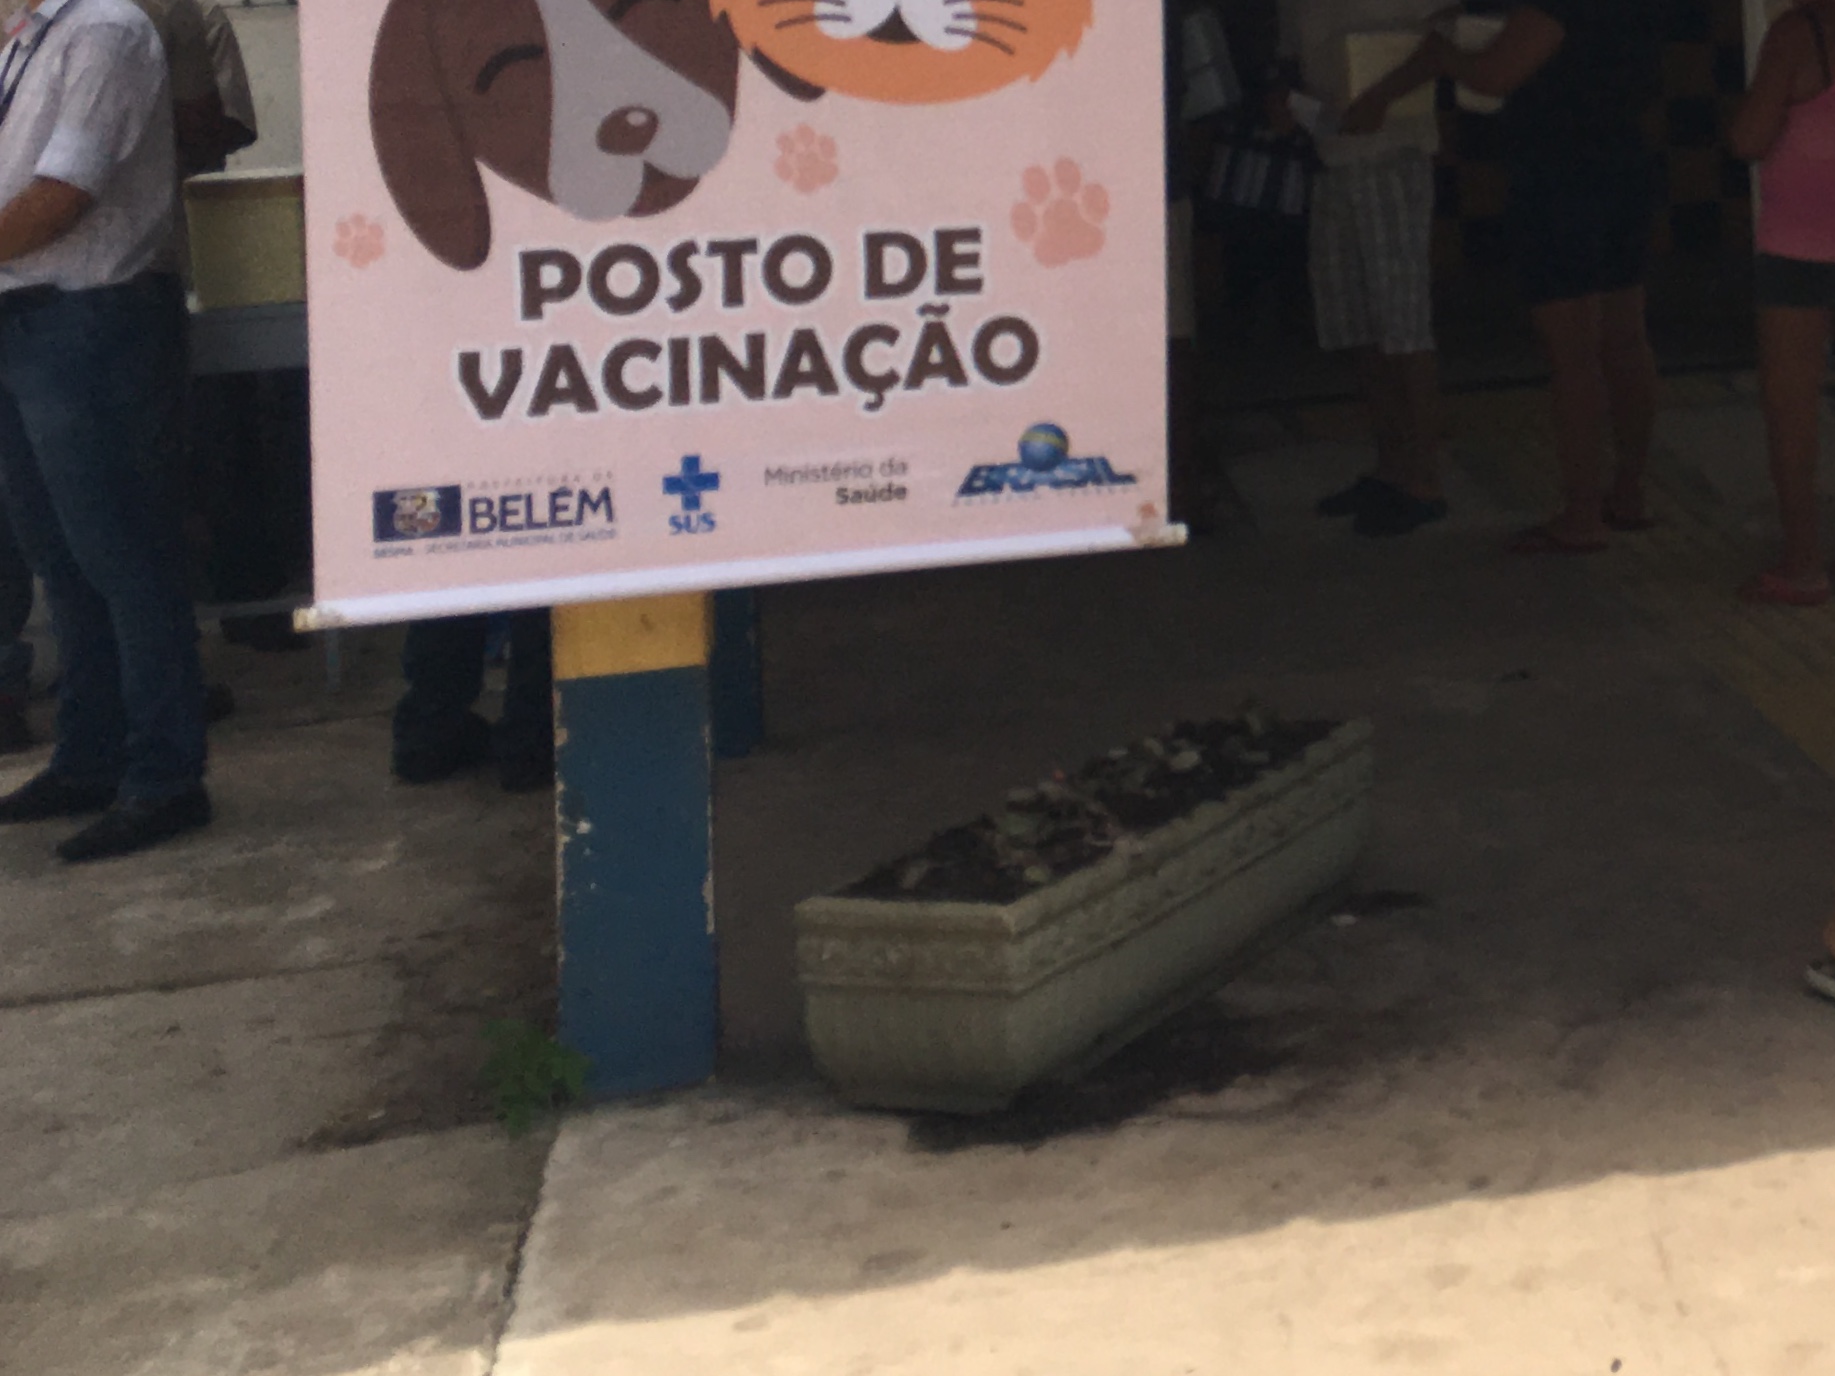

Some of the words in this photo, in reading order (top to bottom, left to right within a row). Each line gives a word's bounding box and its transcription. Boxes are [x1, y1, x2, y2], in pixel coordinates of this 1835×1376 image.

[518, 235, 834, 321] POSTO
[862, 227, 984, 301] DE
[457, 304, 1040, 421] VACINAÇÃO
[764, 460, 873, 487] Ministério
[879, 457, 909, 478] da
[467, 485, 617, 535] BELÉM
[835, 480, 909, 506] Saúde
[668, 512, 718, 536] SUS
